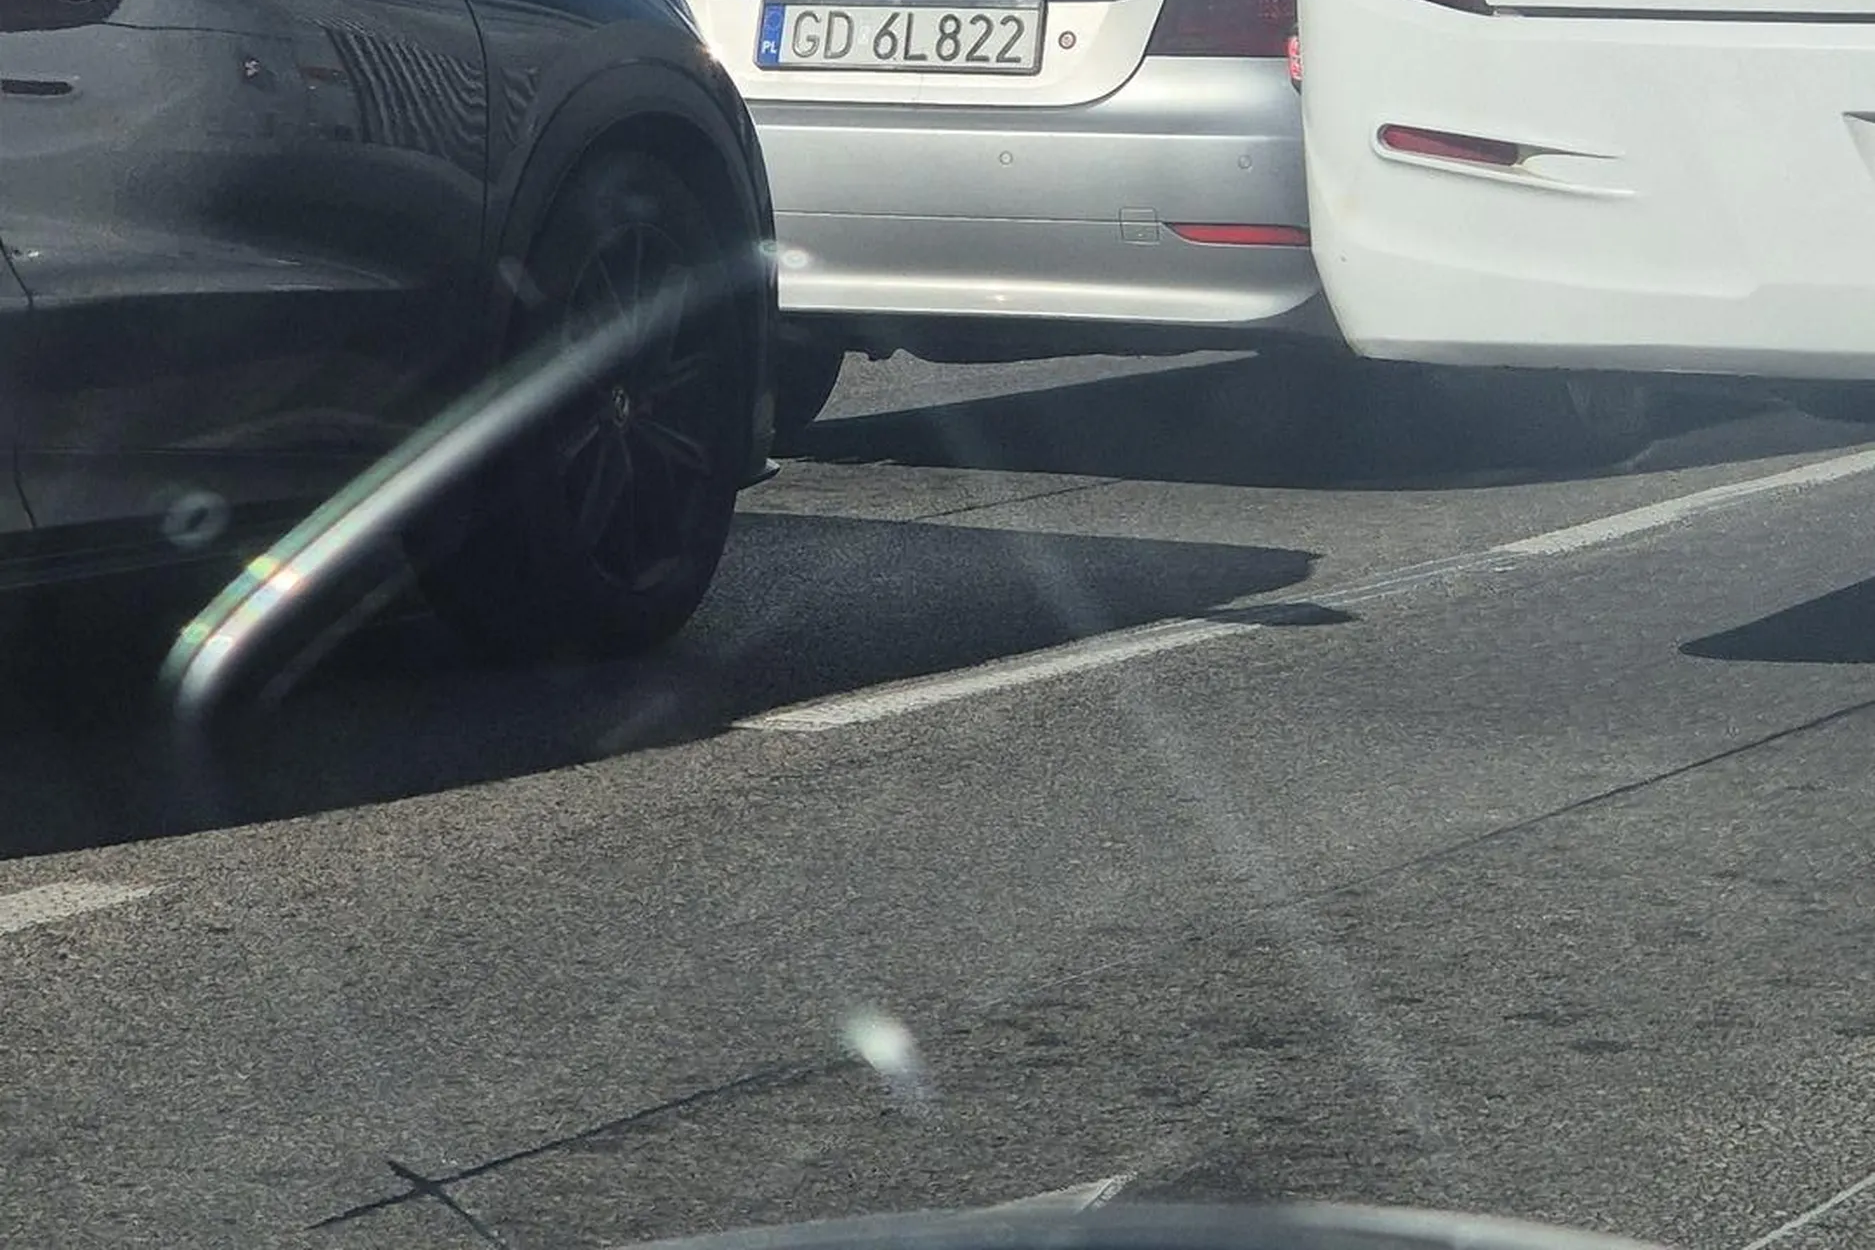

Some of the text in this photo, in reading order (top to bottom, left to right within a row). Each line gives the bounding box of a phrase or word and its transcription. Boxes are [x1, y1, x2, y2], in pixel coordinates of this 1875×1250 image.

[762, 40, 777, 55] PL
[792, 10, 1025, 64] GD 6L822
